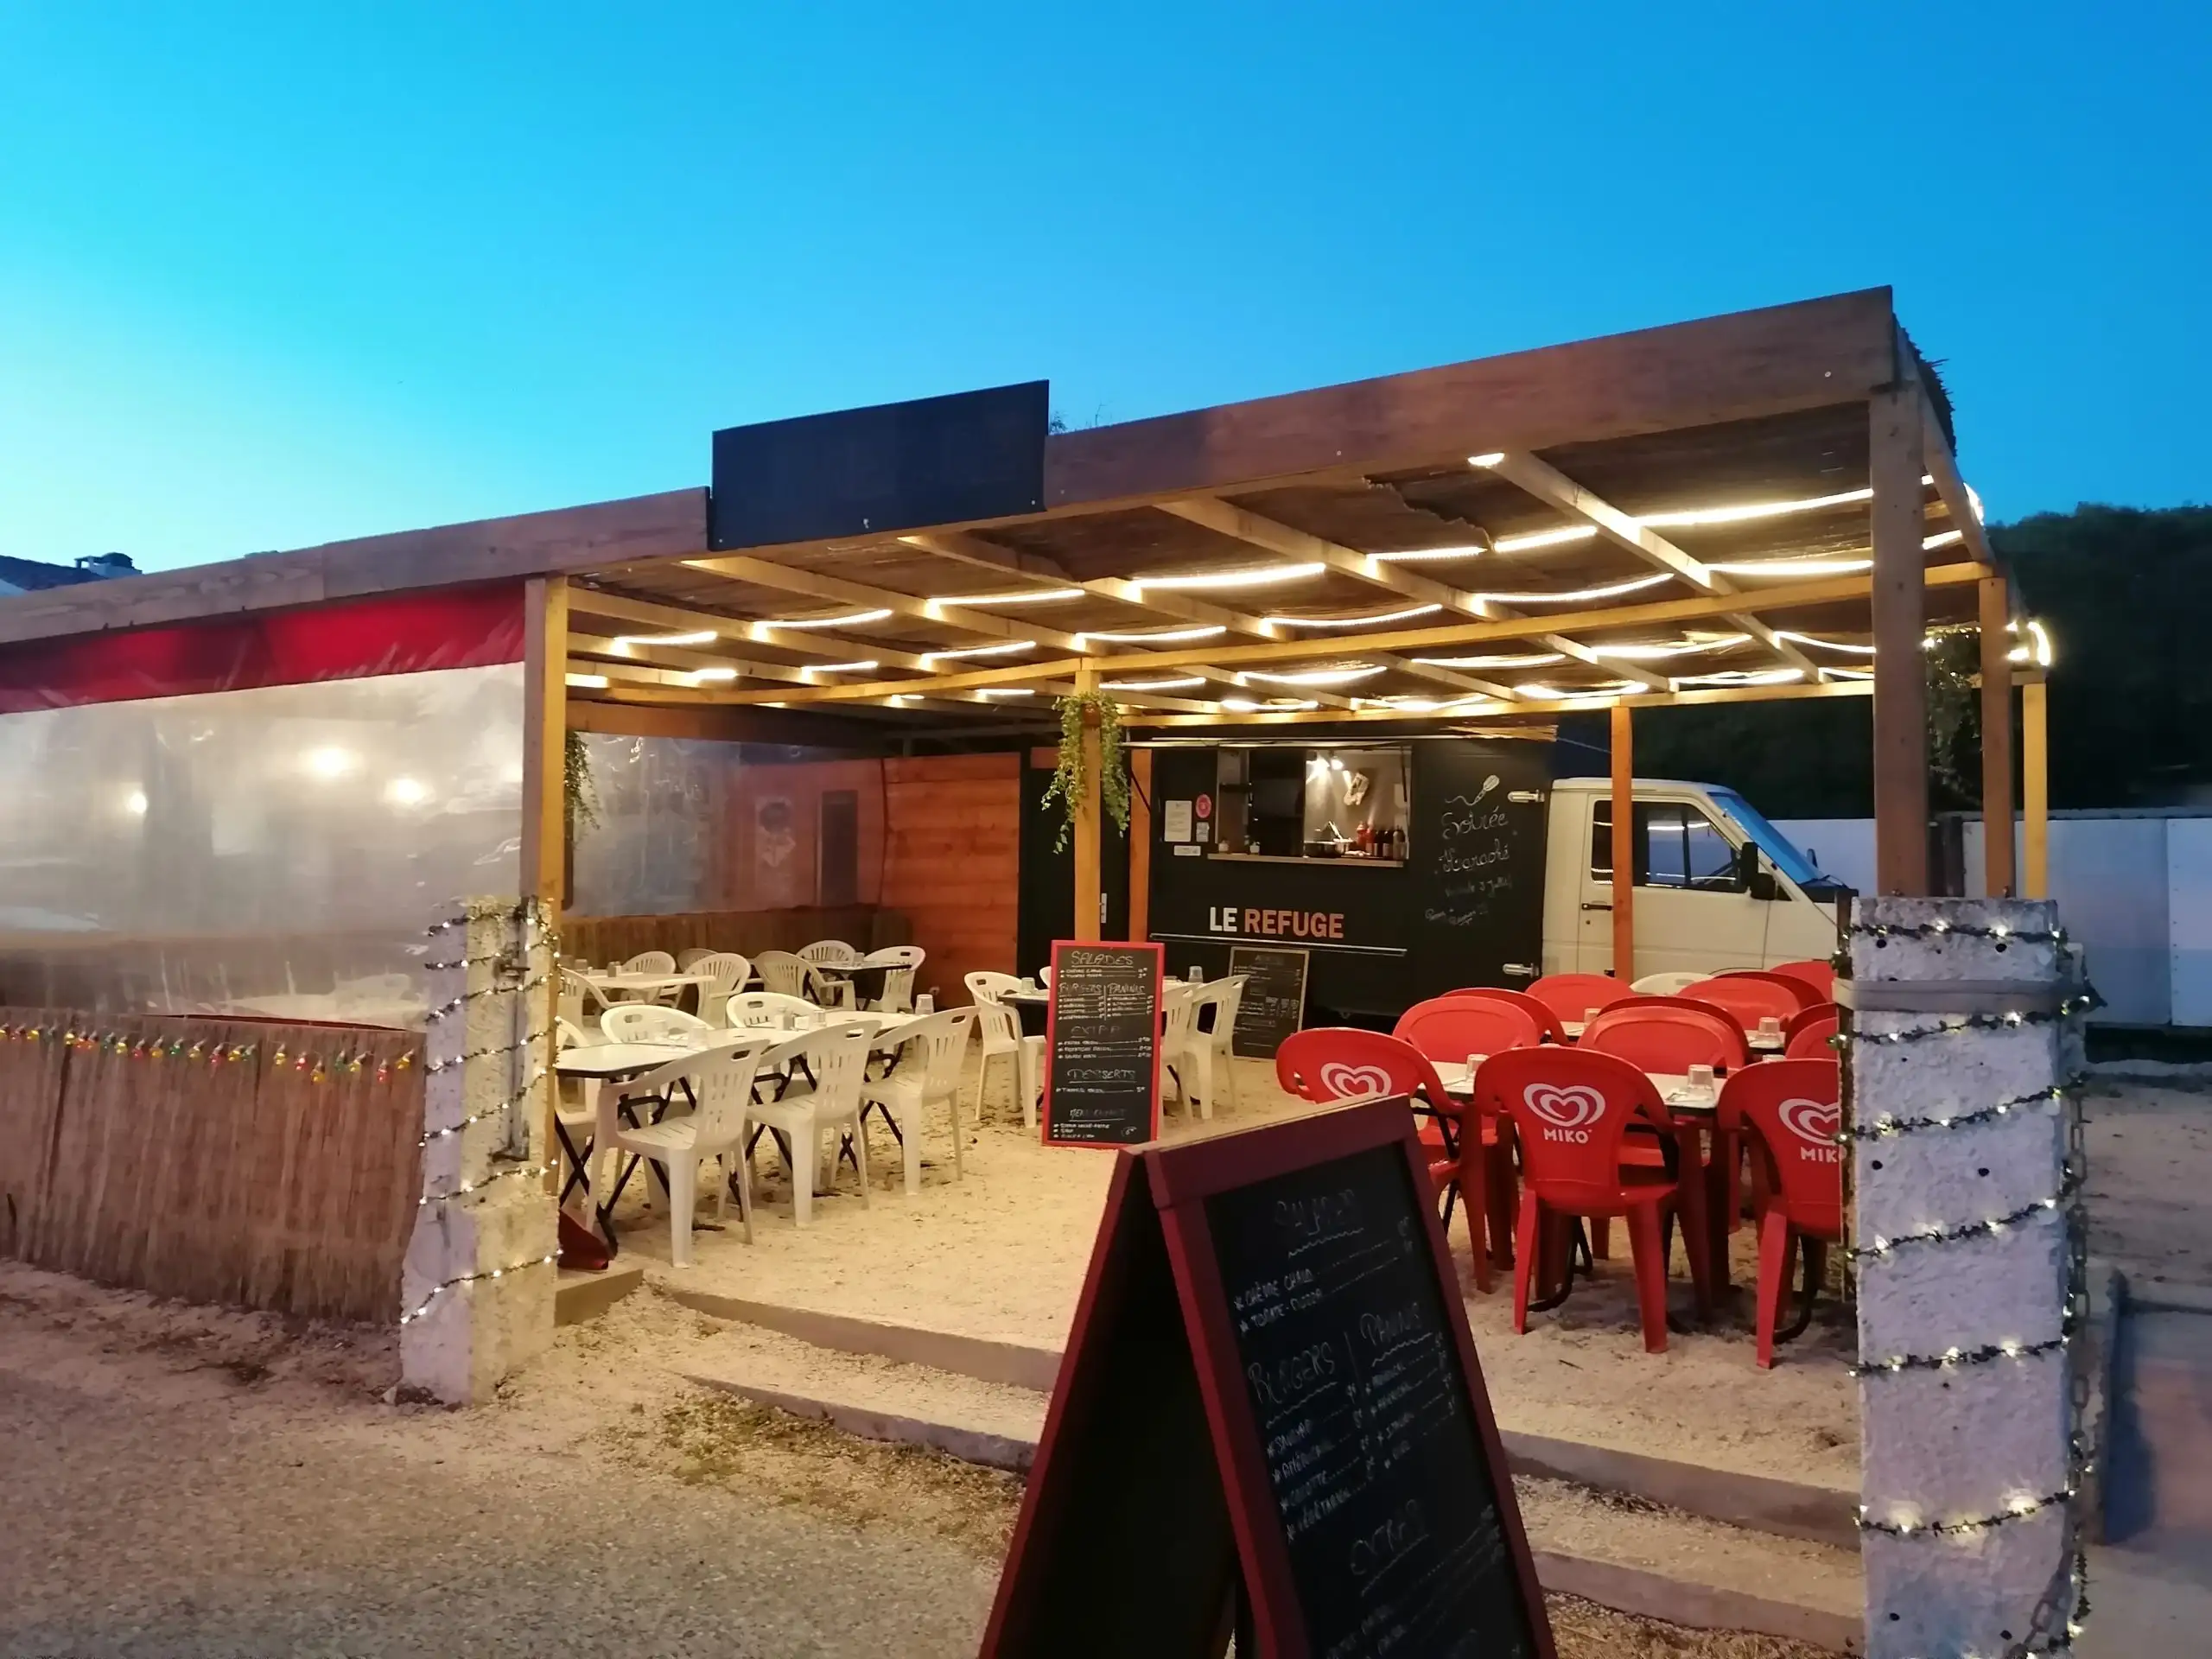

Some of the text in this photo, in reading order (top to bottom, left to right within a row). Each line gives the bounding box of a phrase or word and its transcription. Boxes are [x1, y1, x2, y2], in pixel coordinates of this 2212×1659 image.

[1210, 906, 1344, 938] LE REFUGE
[1071, 950, 1135, 965] SALADES
[1543, 1128, 1589, 1144] MIKO
